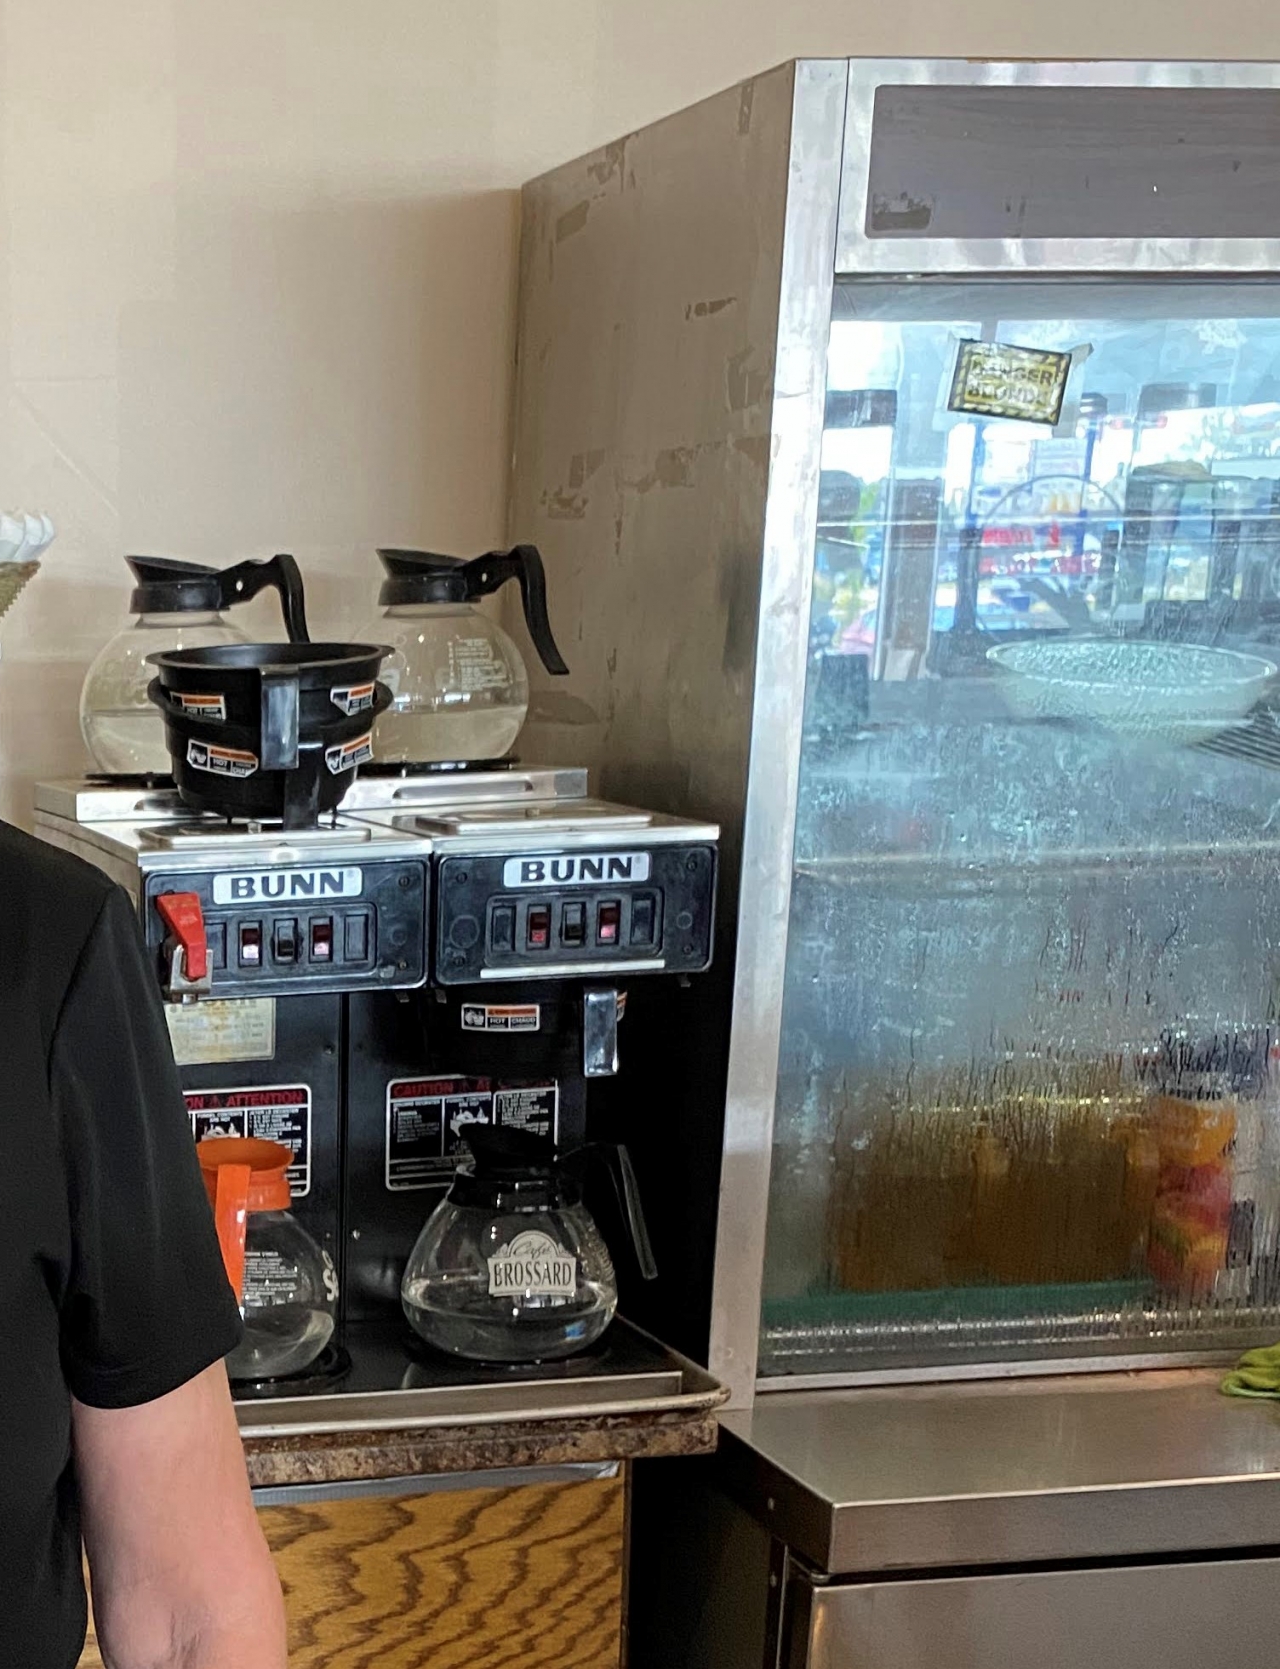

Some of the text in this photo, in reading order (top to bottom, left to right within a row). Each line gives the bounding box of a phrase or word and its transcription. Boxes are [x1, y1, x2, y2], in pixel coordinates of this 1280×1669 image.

[520, 856, 633, 883] BUNN
[230, 871, 344, 900] BUNN
[226, 1089, 305, 1107] ATTENTION
[393, 1081, 454, 1097] CAUTION
[493, 1262, 572, 1288] BROSSARD
